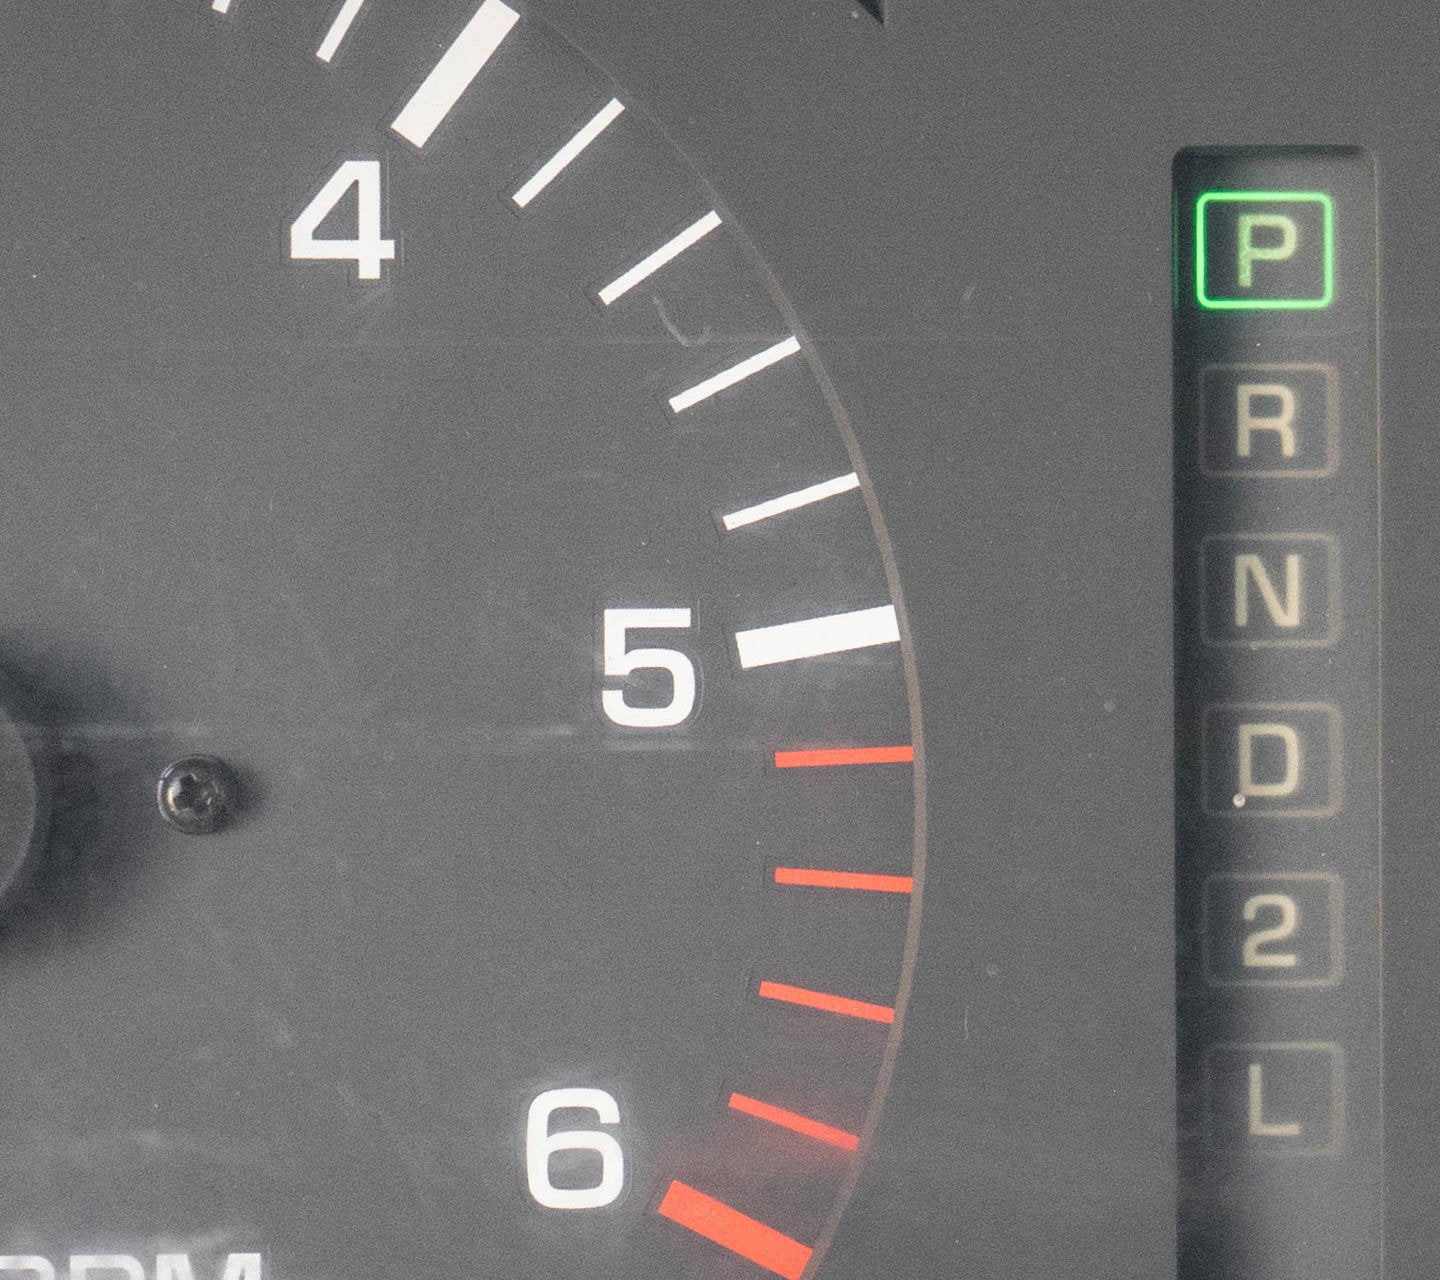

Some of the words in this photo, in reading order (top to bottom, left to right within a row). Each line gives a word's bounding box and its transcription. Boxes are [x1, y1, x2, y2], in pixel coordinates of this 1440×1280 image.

[289, 160, 395, 280] 4
[1236, 213, 1298, 287] P
[1235, 383, 1296, 458] R
[1233, 553, 1302, 627] N
[601, 607, 697, 726] 5
[1237, 723, 1302, 798] D
[1242, 893, 1298, 968] 2
[1247, 1064, 1301, 1137] L
[524, 1087, 625, 1209] 6
